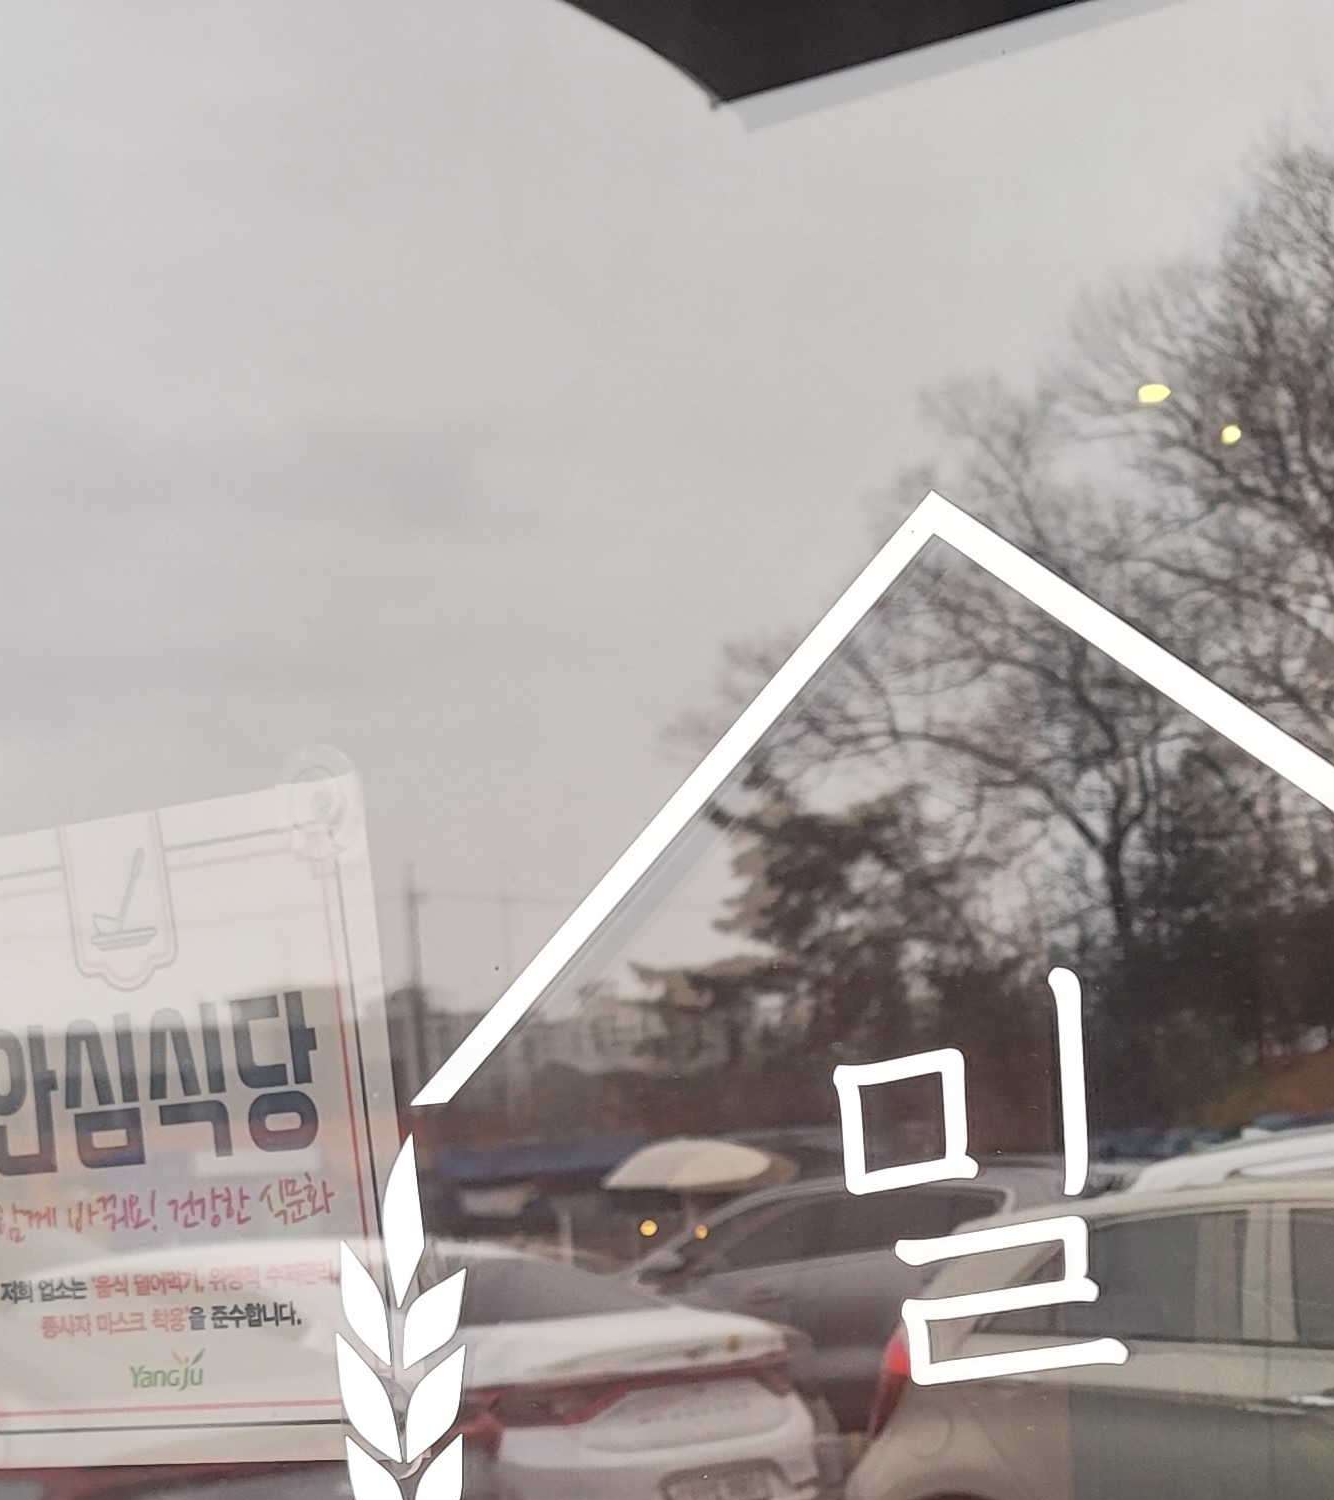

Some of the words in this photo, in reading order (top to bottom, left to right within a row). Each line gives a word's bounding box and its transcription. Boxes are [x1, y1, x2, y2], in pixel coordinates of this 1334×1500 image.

[66, 1189, 159, 1233] 바꿔요!
[167, 1185, 252, 1229] 건강한
[258, 1171, 336, 1227] 식문화
[0, 1280, 34, 1304] 저희
[38, 1277, 88, 1302] 업소는
[40, 1311, 93, 1340] 종사자
[96, 1310, 148, 1335] 마스크
[210, 1300, 302, 1330] 준수합니다.
